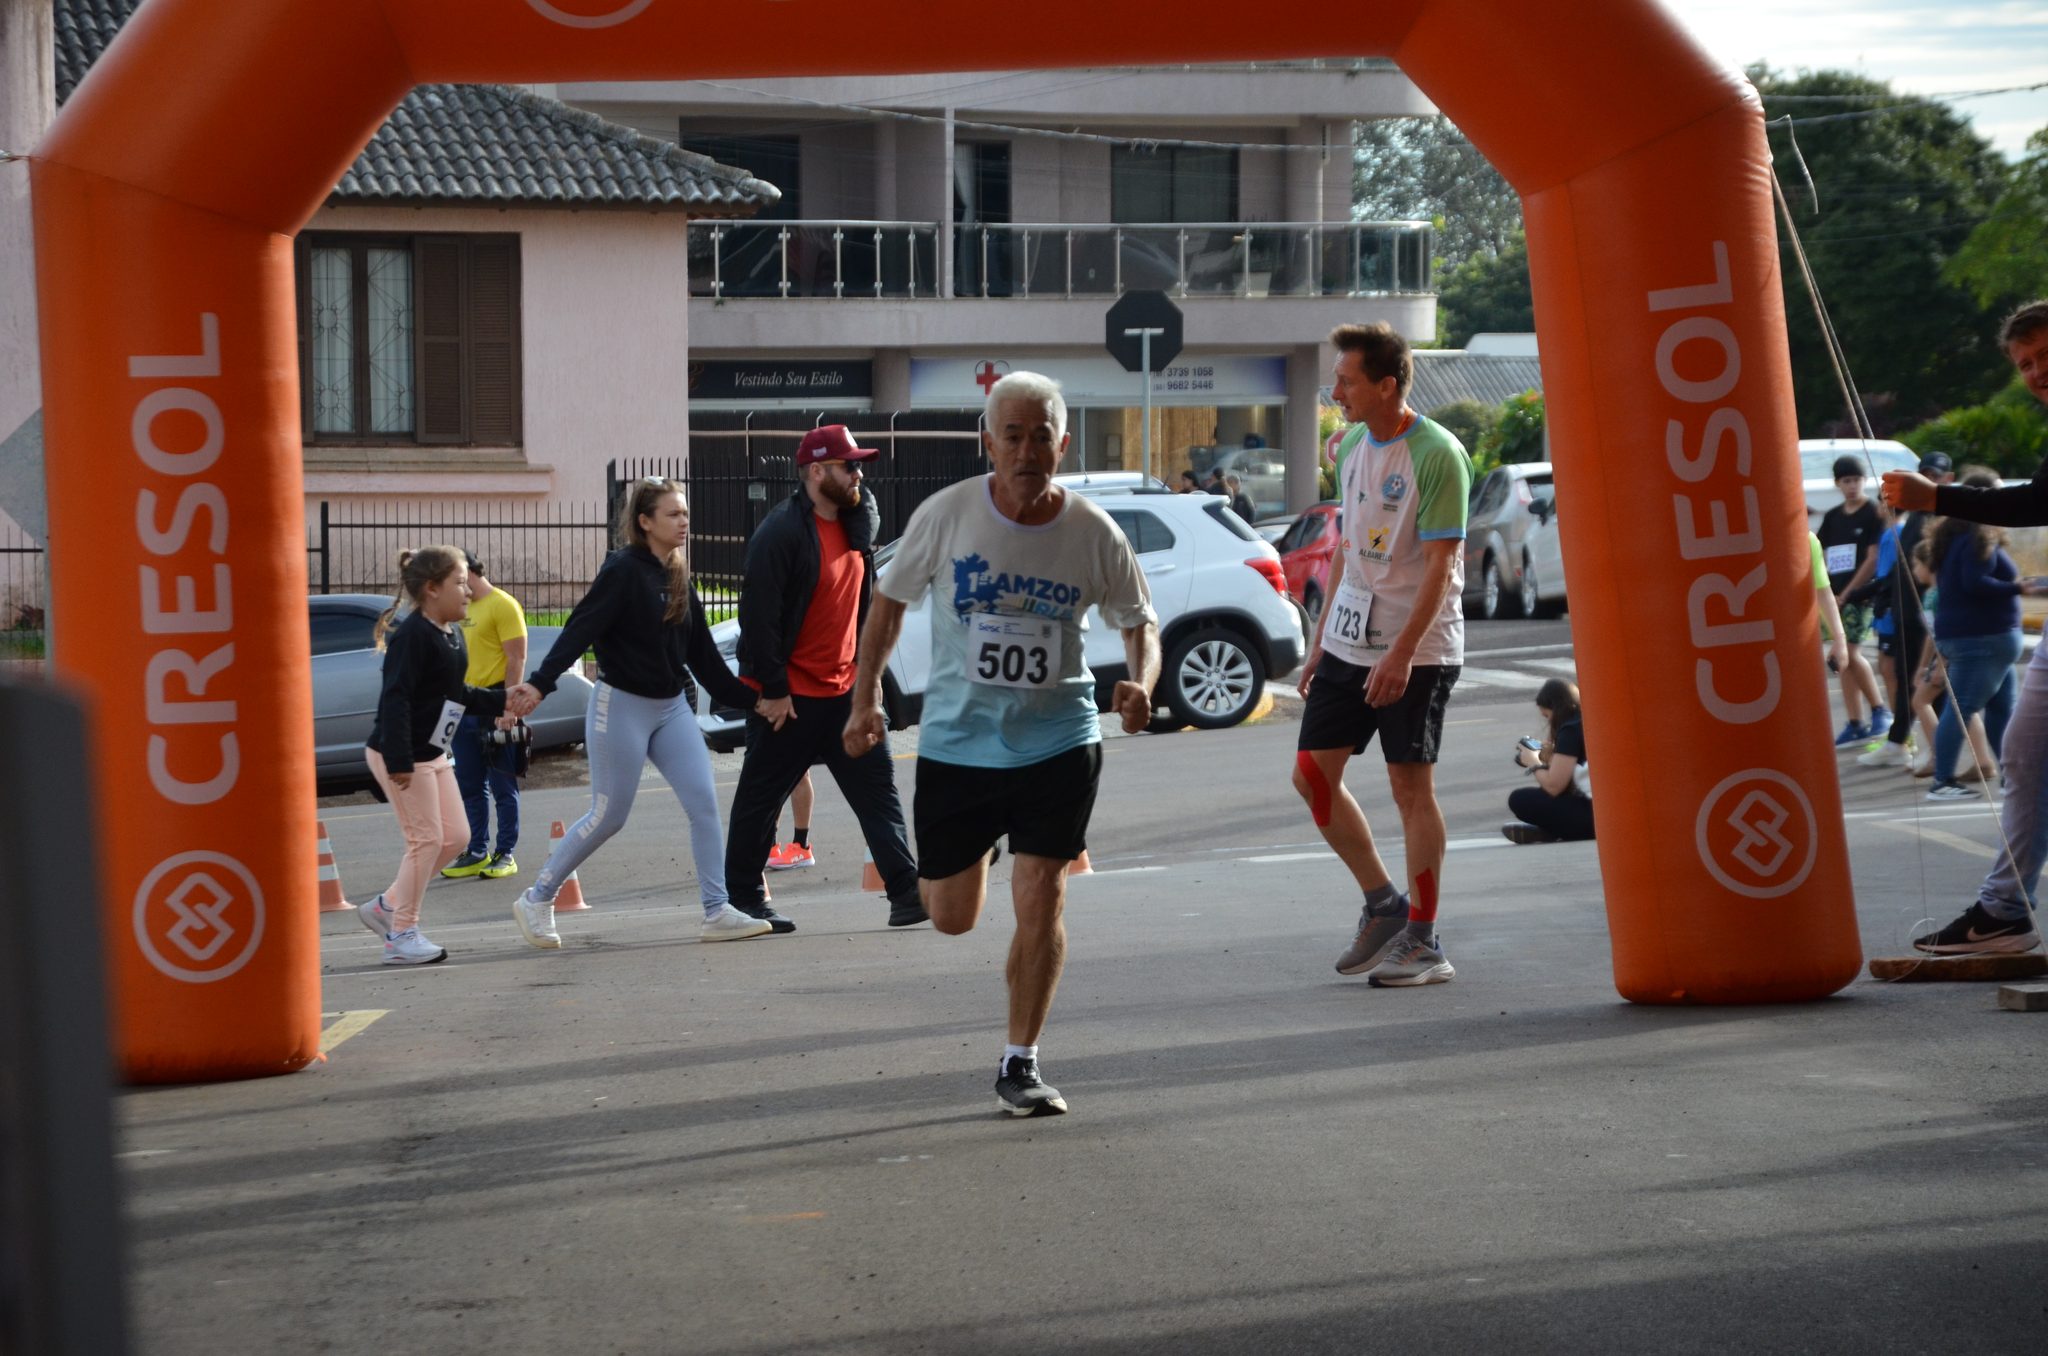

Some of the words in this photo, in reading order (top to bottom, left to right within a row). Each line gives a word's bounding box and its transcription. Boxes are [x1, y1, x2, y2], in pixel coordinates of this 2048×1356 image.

[734, 372, 783, 387] Vestindo
[786, 371, 807, 385] Seu
[810, 371, 843, 385] Estilo
[1648, 240, 1782, 724] CRESOL
[128, 311, 241, 805] CRESOL
[994, 572, 1081, 607] AMZOP
[978, 642, 1048, 684] 503
